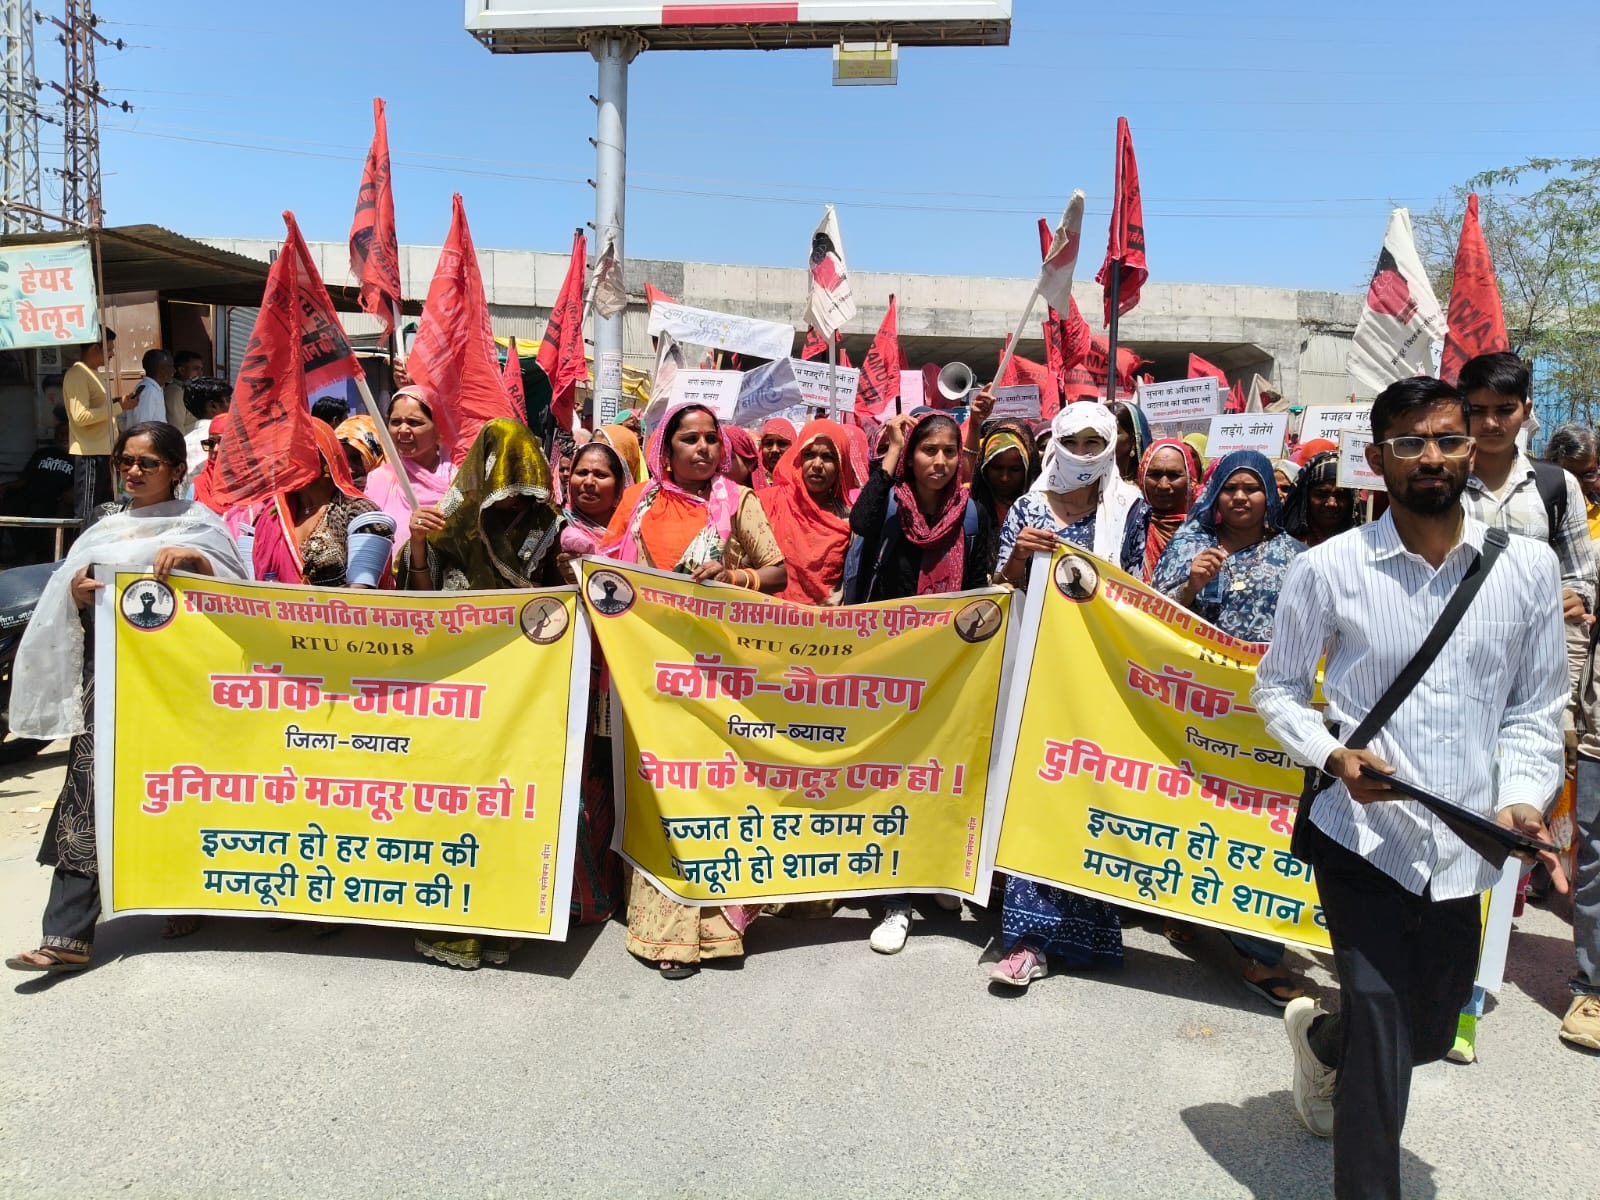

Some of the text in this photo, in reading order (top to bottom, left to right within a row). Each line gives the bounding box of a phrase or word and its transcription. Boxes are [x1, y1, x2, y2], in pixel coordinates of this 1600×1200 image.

[19, 262, 73, 294] हेयर
[16, 300, 85, 339] सैलून
[1175, 384, 1202, 394] अधिकार
[1320, 411, 1352, 422] मजहब
[183, 590, 271, 620] राजस्थान
[276, 596, 367, 627] असंगठित
[370, 607, 435, 636] मजदूर
[438, 603, 516, 634] यूनियन
[639, 587, 726, 621] राजस्थान
[729, 598, 815, 628] असंगठित
[820, 608, 879, 638] मजदूर
[882, 604, 953, 636] यूनियन
[1104, 578, 1192, 630] राजस्थान
[290, 635, 414, 656] RTU 6/2018
[737, 636, 853, 657] RTU 6/2018
[142, 764, 259, 814] दुनिया
[262, 766, 298, 804] के
[304, 777, 407, 822] मजदूर
[413, 783, 471, 815] एक
[476, 777, 514, 818] हो
[637, 751, 702, 790] निया
[705, 752, 738, 789] के
[743, 760, 842, 799] मजदूर
[846, 763, 902, 790] एक
[907, 759, 944, 794] हो
[1039, 738, 1301, 836] दुनिया के मजदू
[200, 823, 480, 868] इज्जत हो हर काम की
[738, 805, 764, 842] हो
[771, 814, 803, 841] हर
[809, 814, 866, 837] काम
[872, 805, 909, 838] की
[1087, 807, 1313, 883] इज्जत हो हर का
[203, 862, 299, 907] मजदूरी
[306, 865, 336, 903] हो
[343, 876, 407, 905] शान
[414, 873, 453, 909] की
[748, 846, 774, 884] हो
[782, 853, 840, 879] शान
[847, 843, 883, 876] की
[1083, 848, 1183, 901] मजदूरी
[1190, 867, 1224, 905] हो
[1231, 884, 1305, 924] शान
